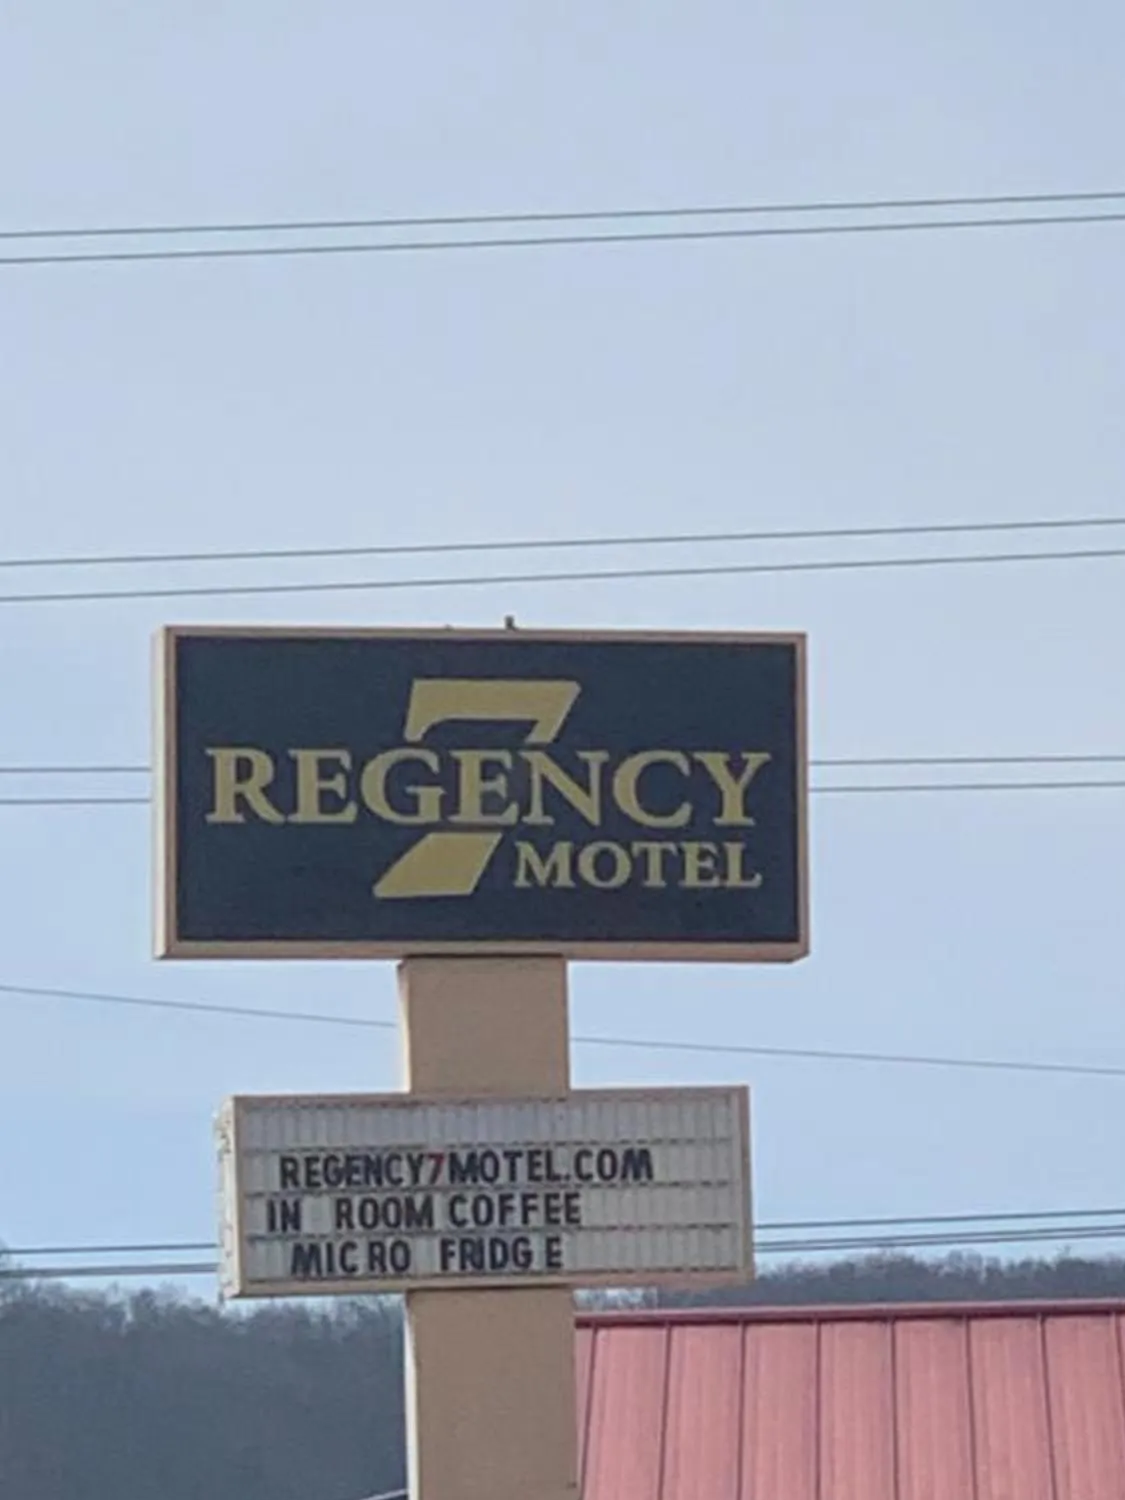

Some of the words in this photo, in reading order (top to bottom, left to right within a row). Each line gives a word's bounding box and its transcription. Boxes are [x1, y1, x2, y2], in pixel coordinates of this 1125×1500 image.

[205, 748, 771, 827] REGENCY
[373, 678, 582, 897] 7
[514, 841, 762, 888] MOTEL
[280, 1148, 654, 1188] REGENCY7MOTEL.COM
[267, 1201, 302, 1232] IN
[334, 1197, 434, 1230] ROOM
[448, 1192, 581, 1228] COFFEE
[290, 1239, 412, 1276] MICRO
[439, 1236, 562, 1272] FRIDGE
